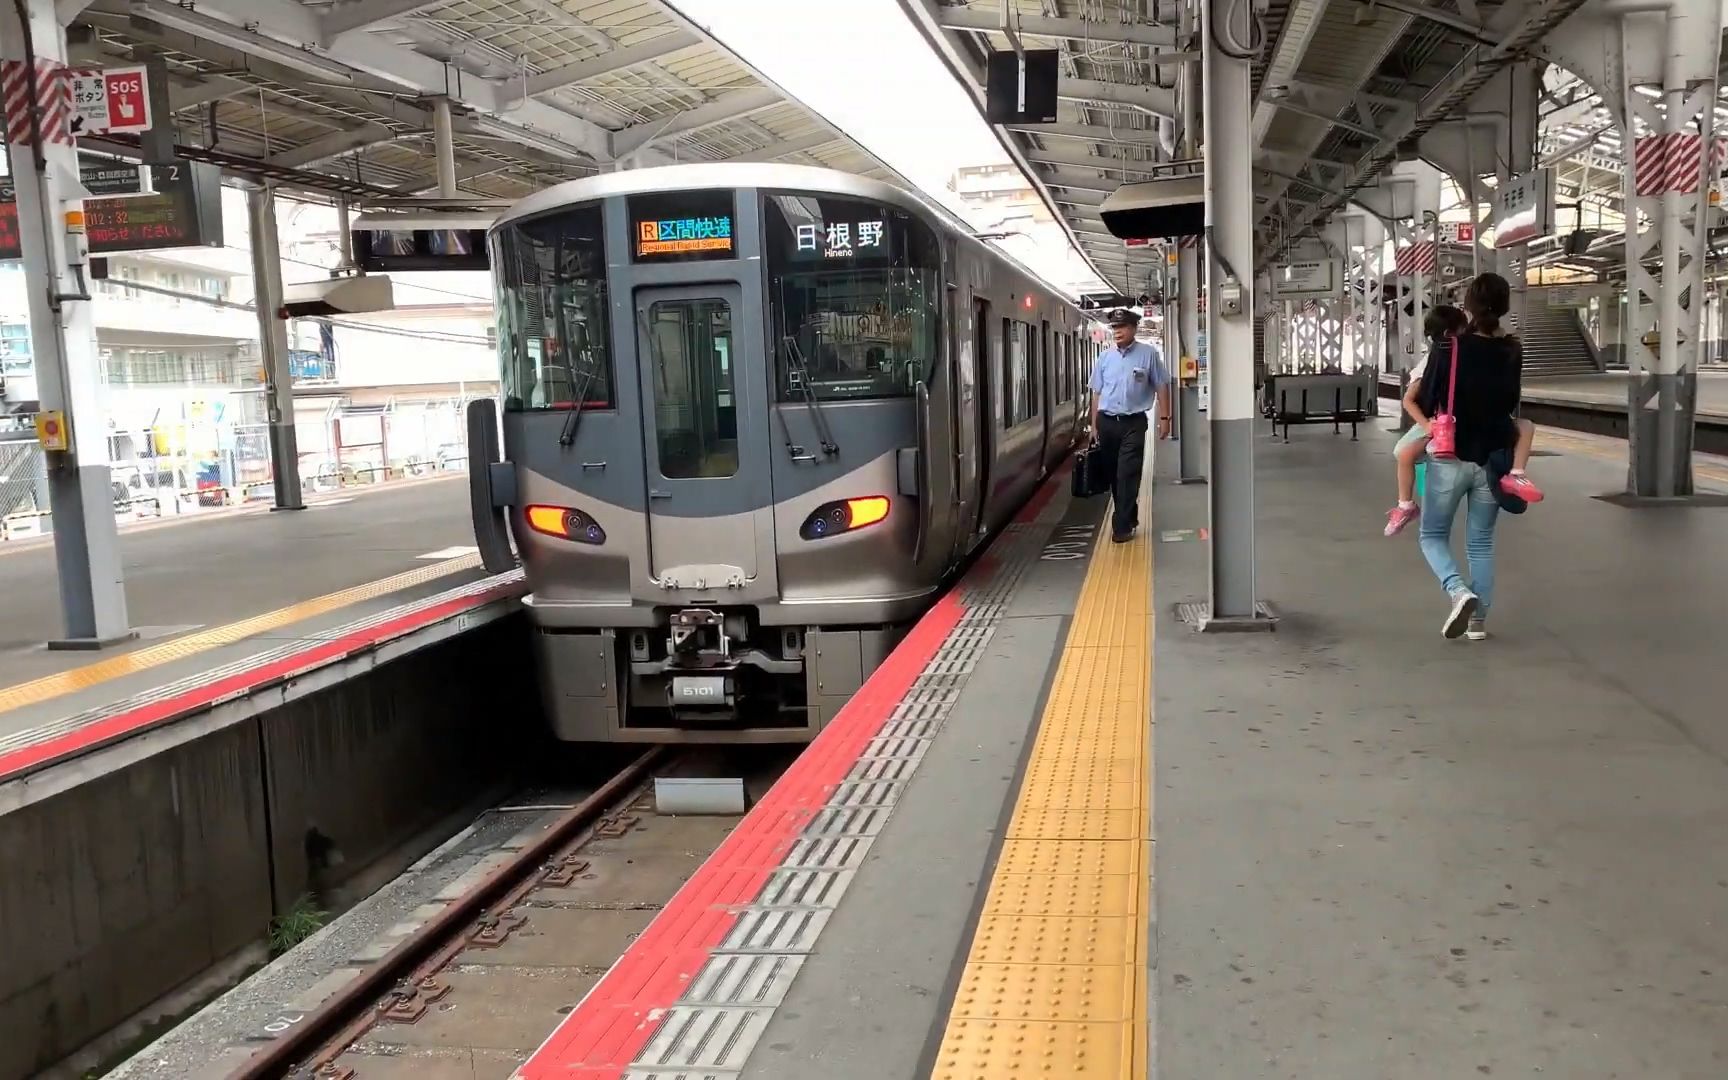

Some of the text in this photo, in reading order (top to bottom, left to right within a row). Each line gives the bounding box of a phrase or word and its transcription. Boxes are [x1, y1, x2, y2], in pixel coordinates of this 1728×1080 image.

[110, 80, 140, 94] SOS
[169, 165, 180, 181] 2
[643, 216, 731, 240] R 区間快速
[796, 221, 883, 251] 日根野
[824, 248, 853, 258] Hineno
